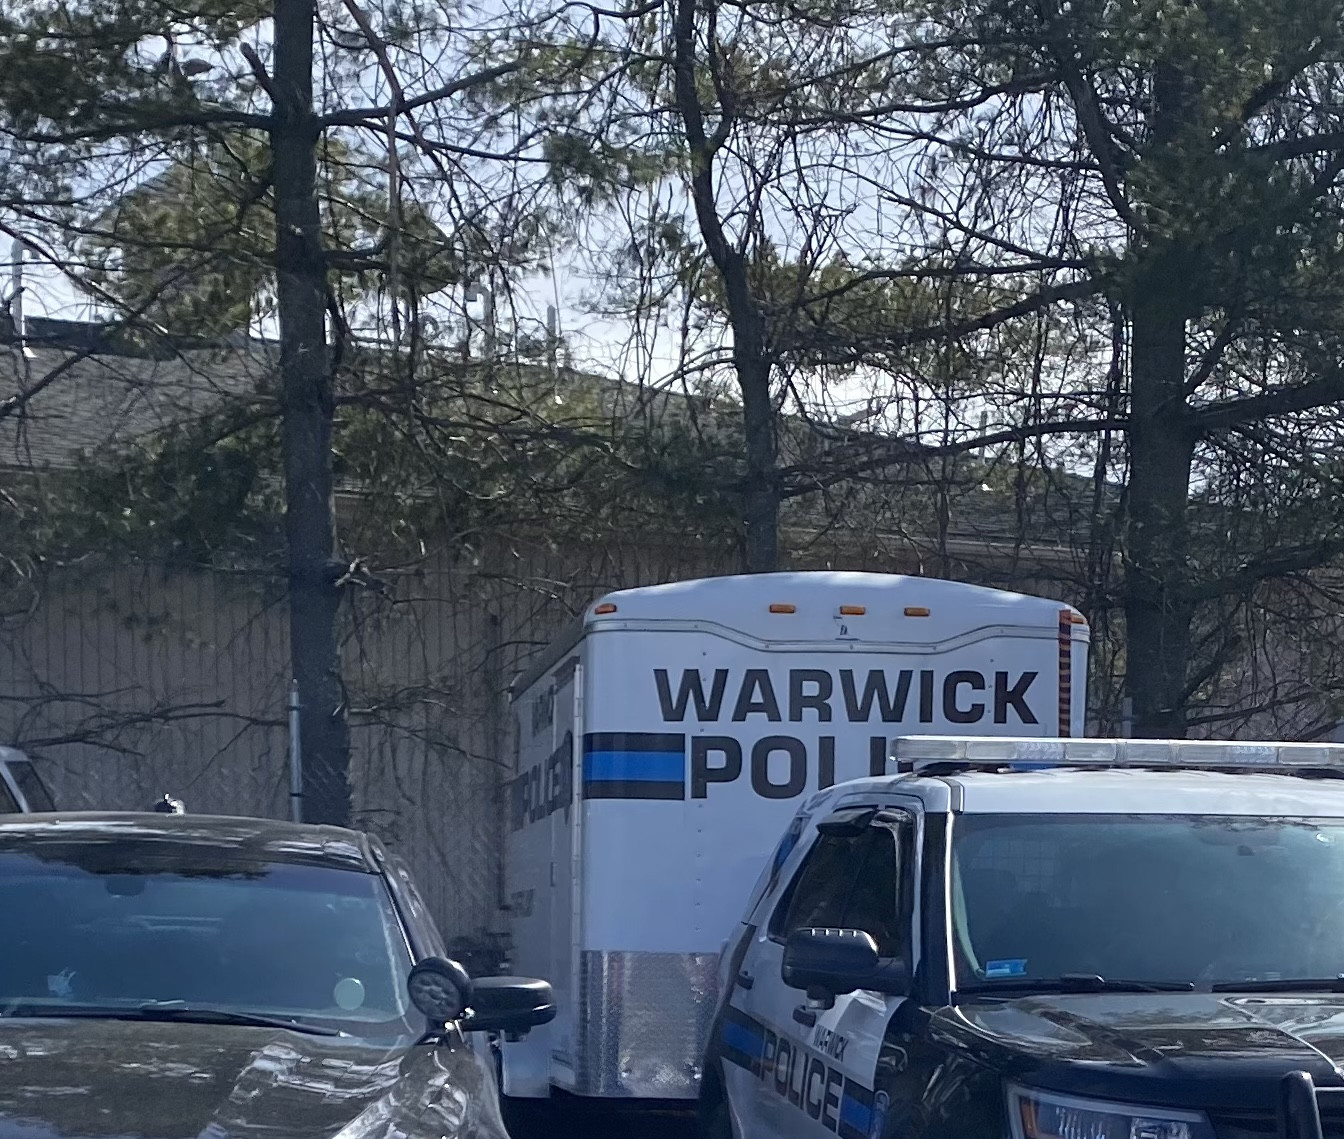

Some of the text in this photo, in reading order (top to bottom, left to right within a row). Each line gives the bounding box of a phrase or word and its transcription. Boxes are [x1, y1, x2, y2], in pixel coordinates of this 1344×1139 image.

[653, 668, 1039, 724] WARWICK
[690, 735, 913, 799] POLI
[760, 1028, 844, 1133] POLICE
